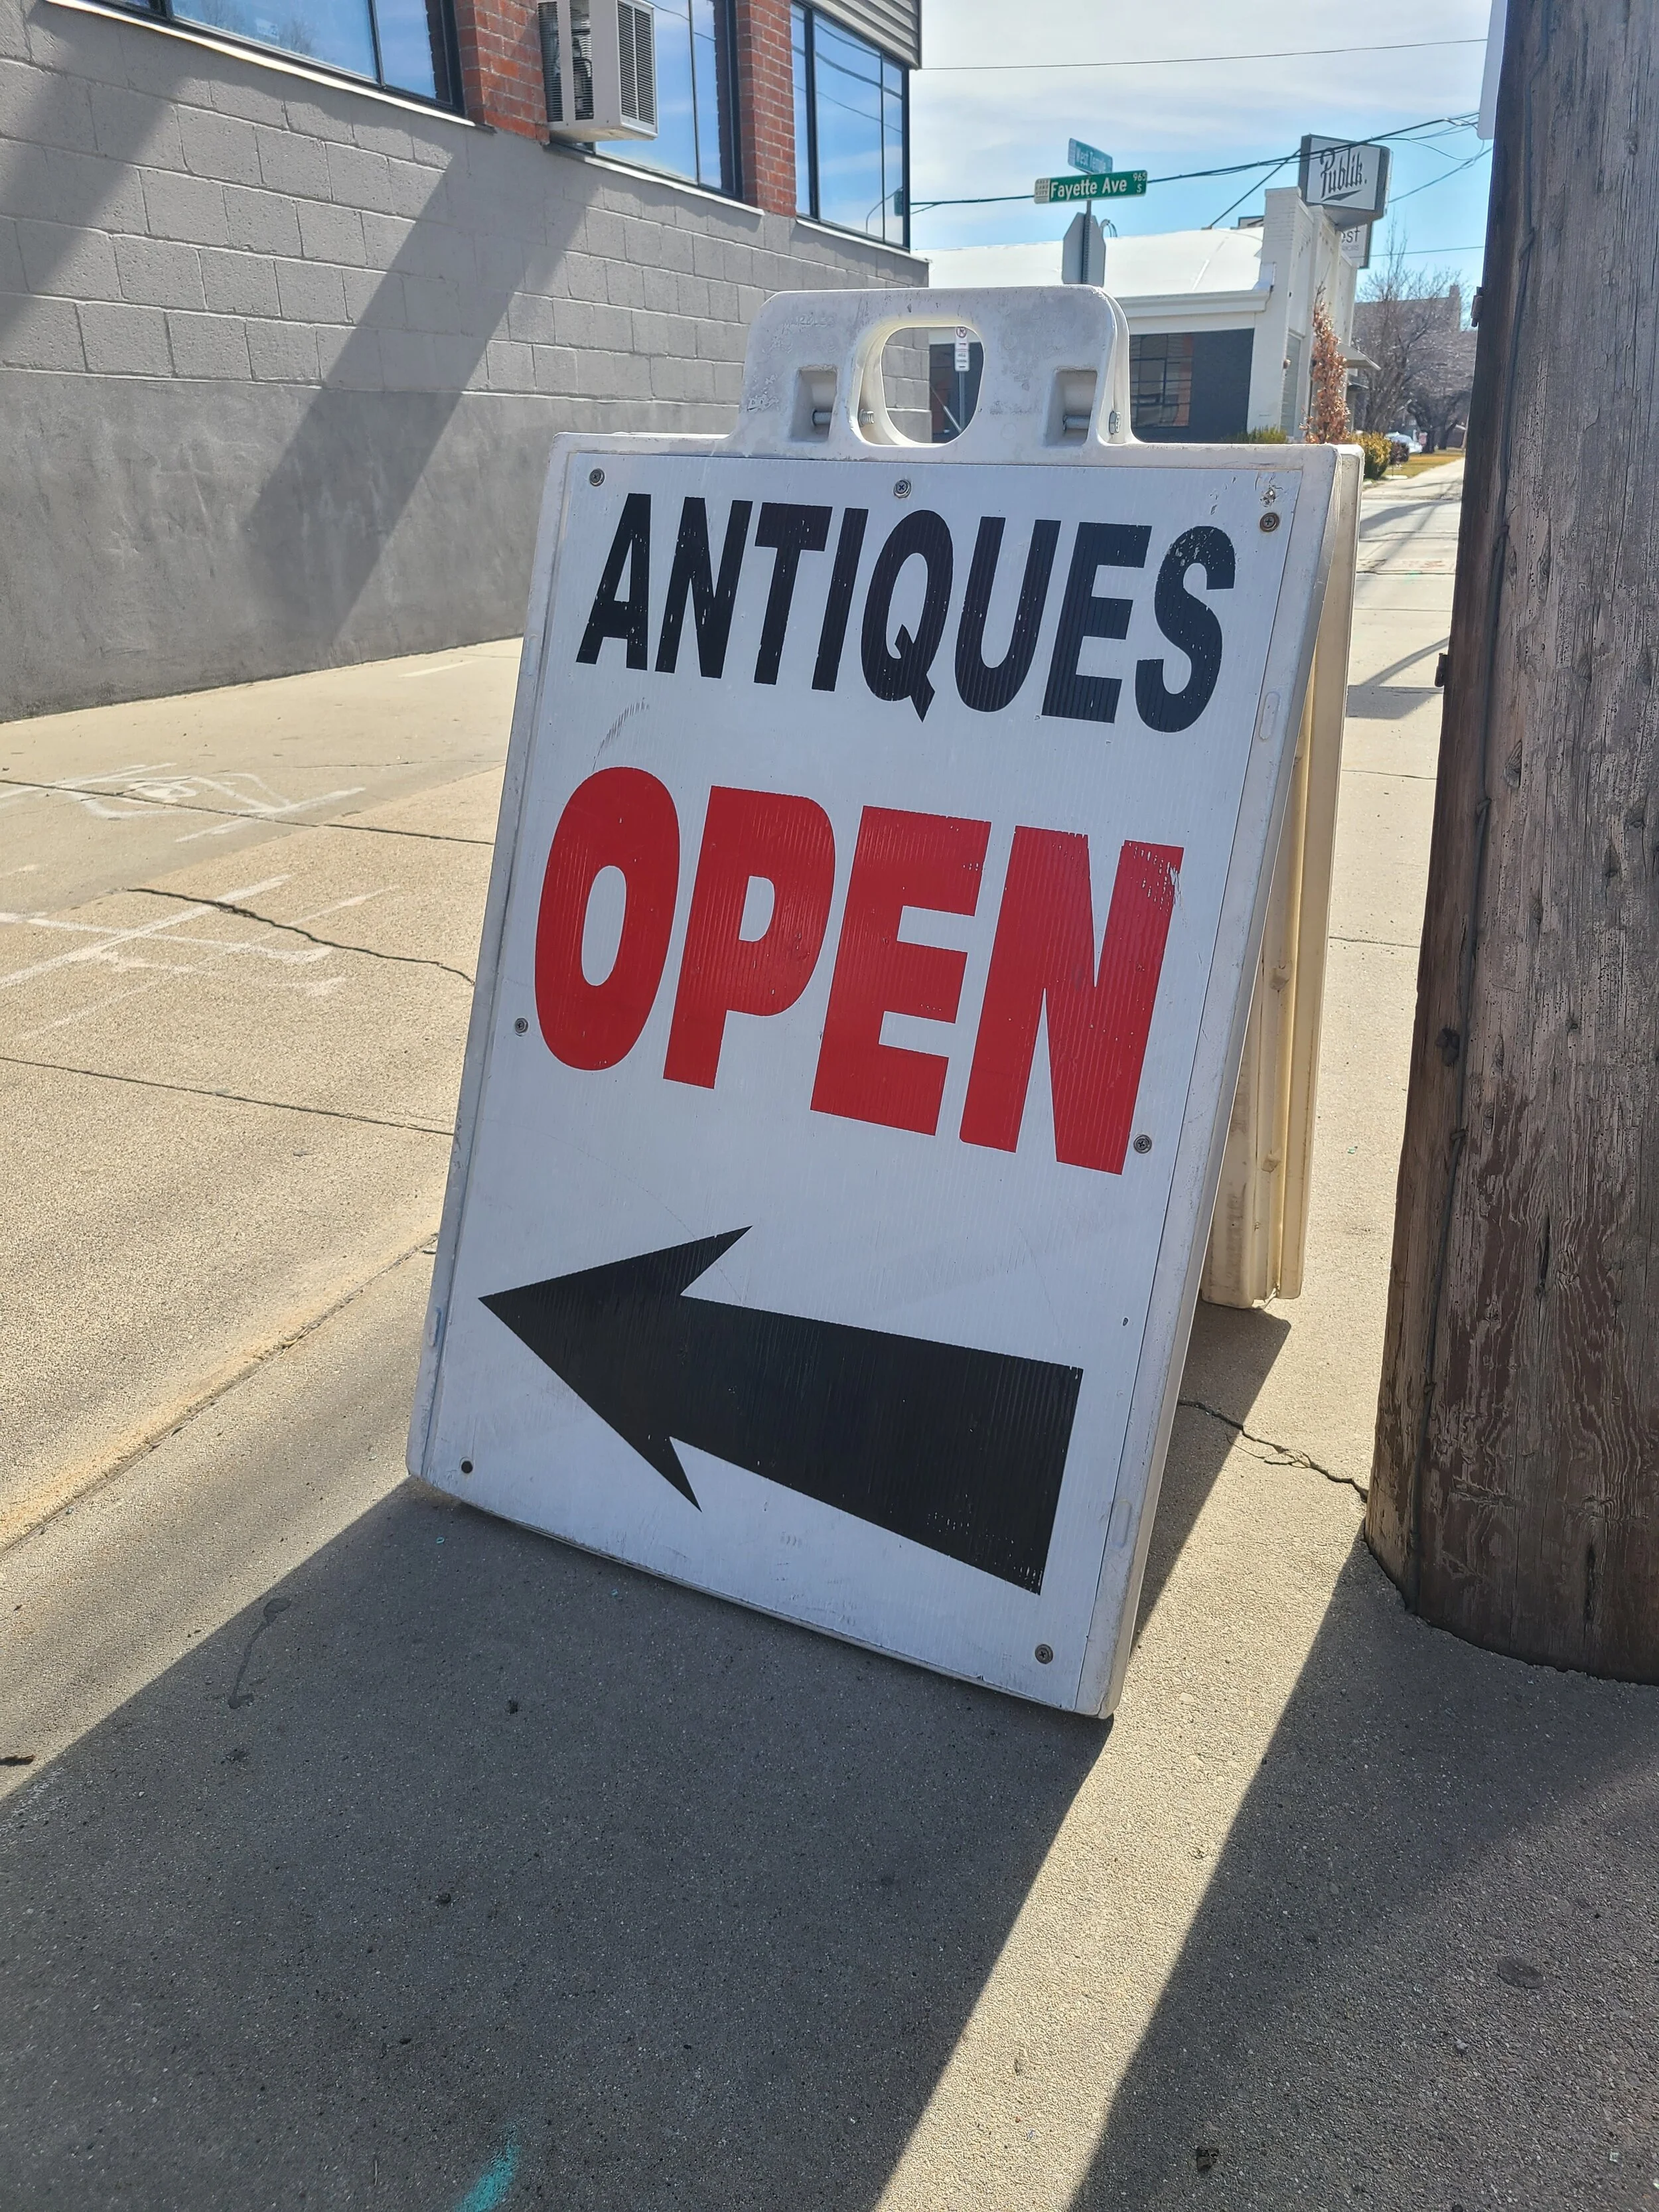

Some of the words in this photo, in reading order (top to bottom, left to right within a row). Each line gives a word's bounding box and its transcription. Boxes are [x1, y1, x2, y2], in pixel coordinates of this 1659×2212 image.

[1050, 179, 1098, 201] Fayette
[1102, 177, 1127, 194] Ave
[1133, 173, 1147, 181] 965
[1136, 183, 1142, 193] S
[576, 492, 1236, 733] ANTIQUES
[534, 767, 1185, 1176] OPEN
